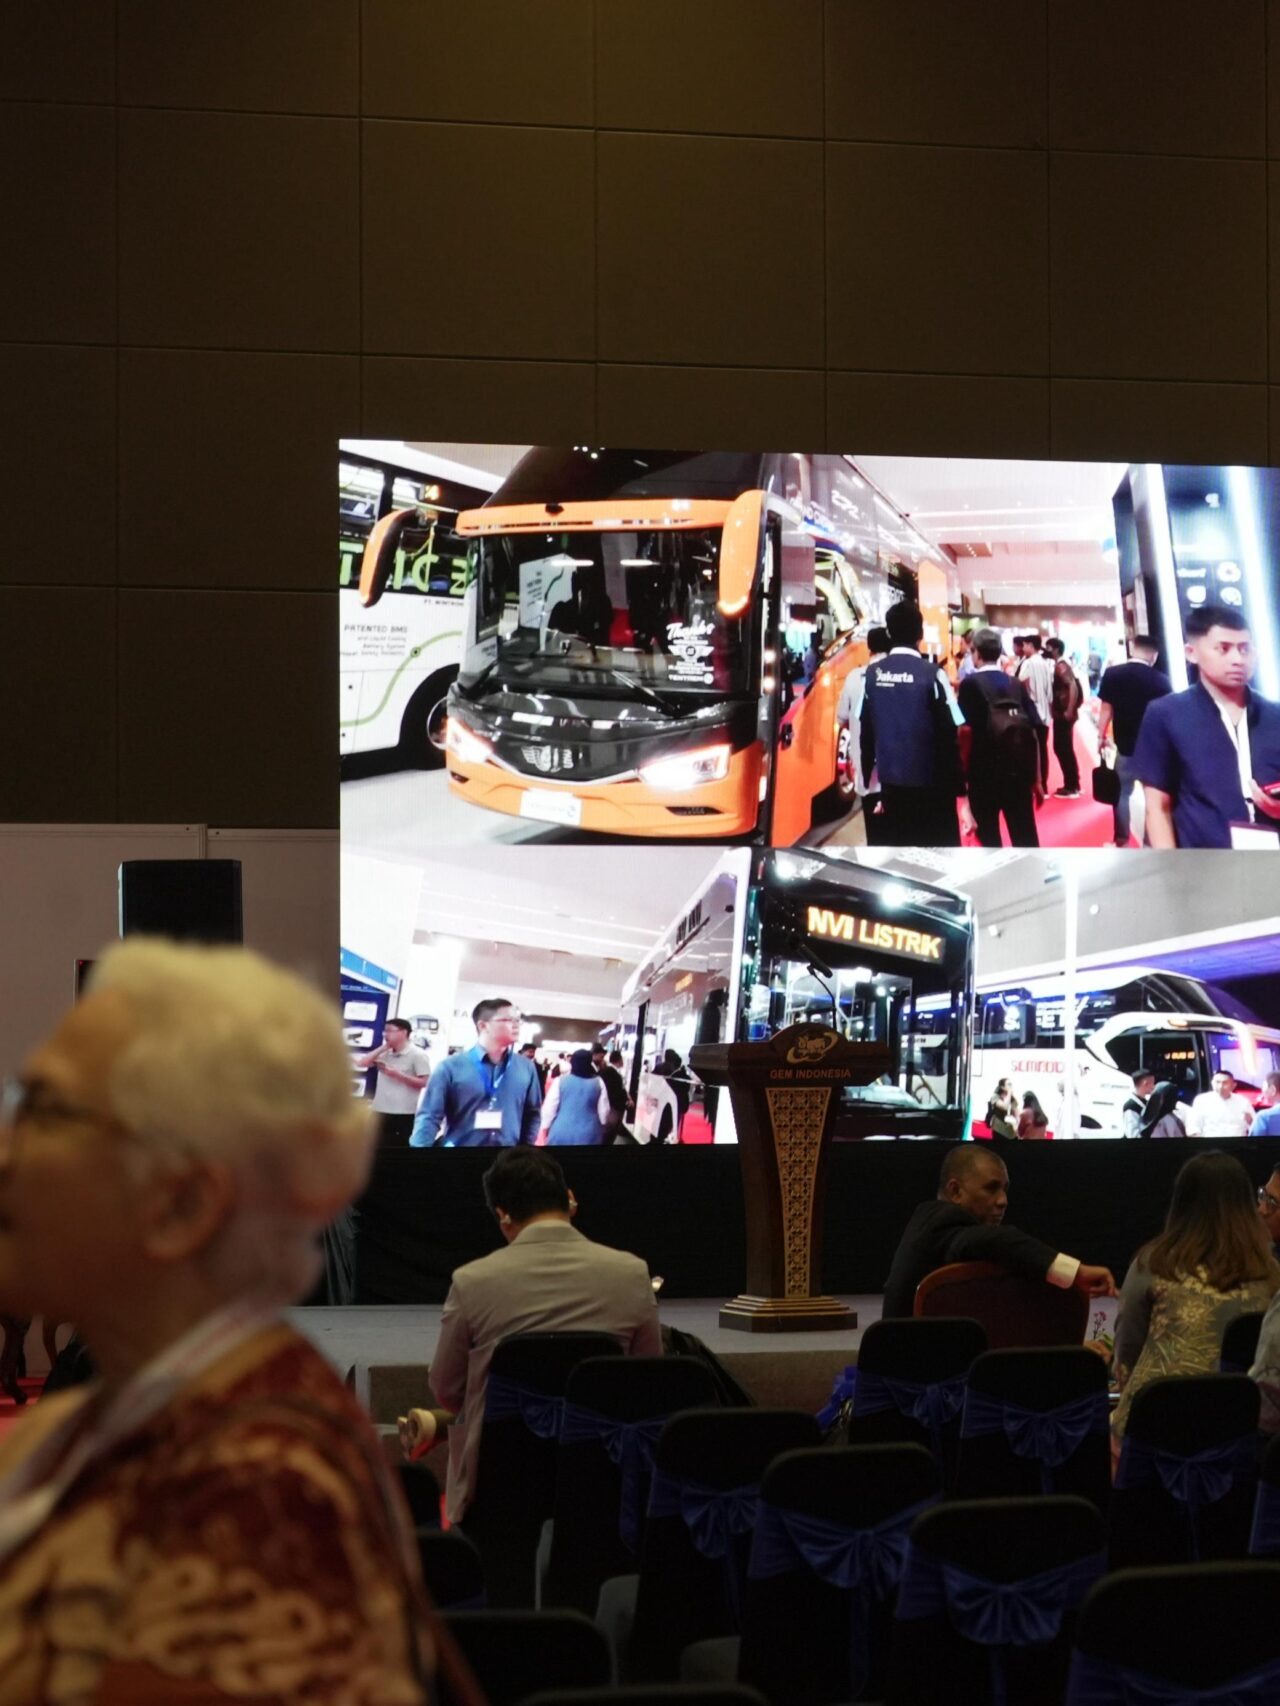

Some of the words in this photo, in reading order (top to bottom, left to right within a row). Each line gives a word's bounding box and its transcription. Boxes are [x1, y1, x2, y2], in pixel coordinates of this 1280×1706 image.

[344, 624, 388, 633] PATENTED
[875, 667, 914, 683] Jakarta
[859, 918, 942, 959] LISTRIK
[769, 1068, 794, 1079] GEM
[795, 1068, 852, 1079] INDONESIA
